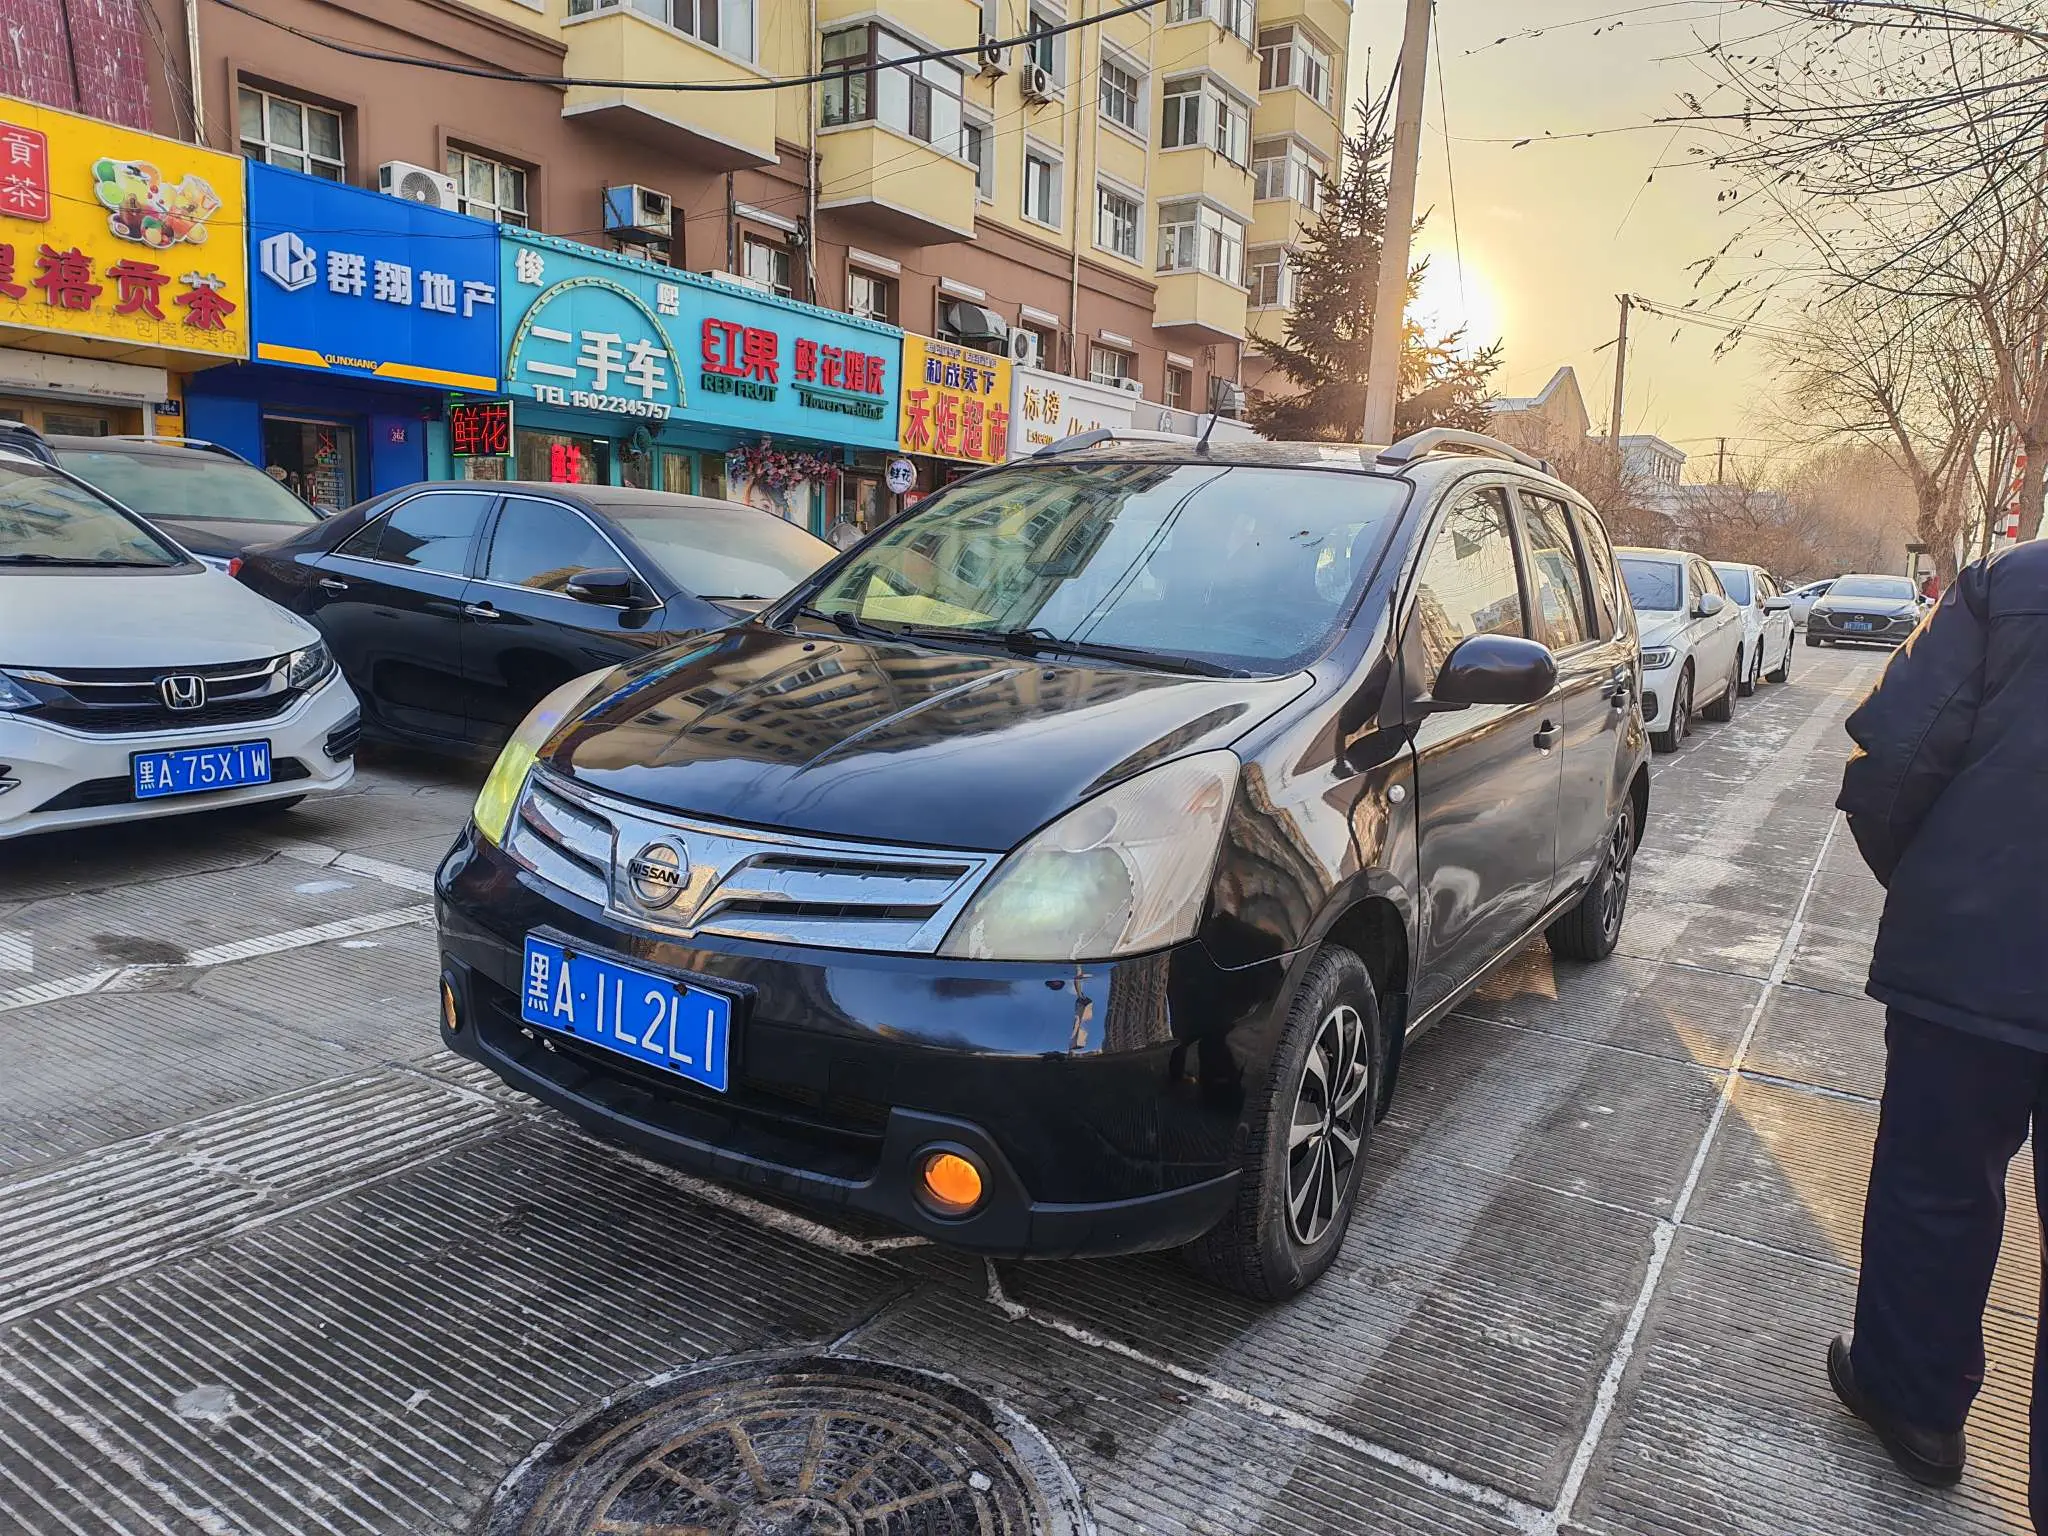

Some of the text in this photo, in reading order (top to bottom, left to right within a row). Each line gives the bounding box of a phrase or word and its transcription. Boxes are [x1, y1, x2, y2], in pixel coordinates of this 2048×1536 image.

[1, 131, 43, 208] 貢茶
[327, 250, 496, 318] 群翔地产
[515, 248, 545, 287] 俊
[325, 353, 378, 371] QUNXIANG
[526, 325, 668, 399] 二手车
[701, 317, 780, 384] 红果
[795, 337, 887, 395] 鲜花婚庆
[702, 373, 778, 402] RED FRUIT
[925, 356, 997, 396] 和成天下
[532, 383, 672, 421] TEL 15022345757
[1023, 385, 1061, 425] 标榜
[453, 405, 508, 454] 鲜花
[905, 388, 1010, 464] 禾炬超市
[889, 467, 911, 482] 鲜花
[630, 862, 680, 885] NISSAN
